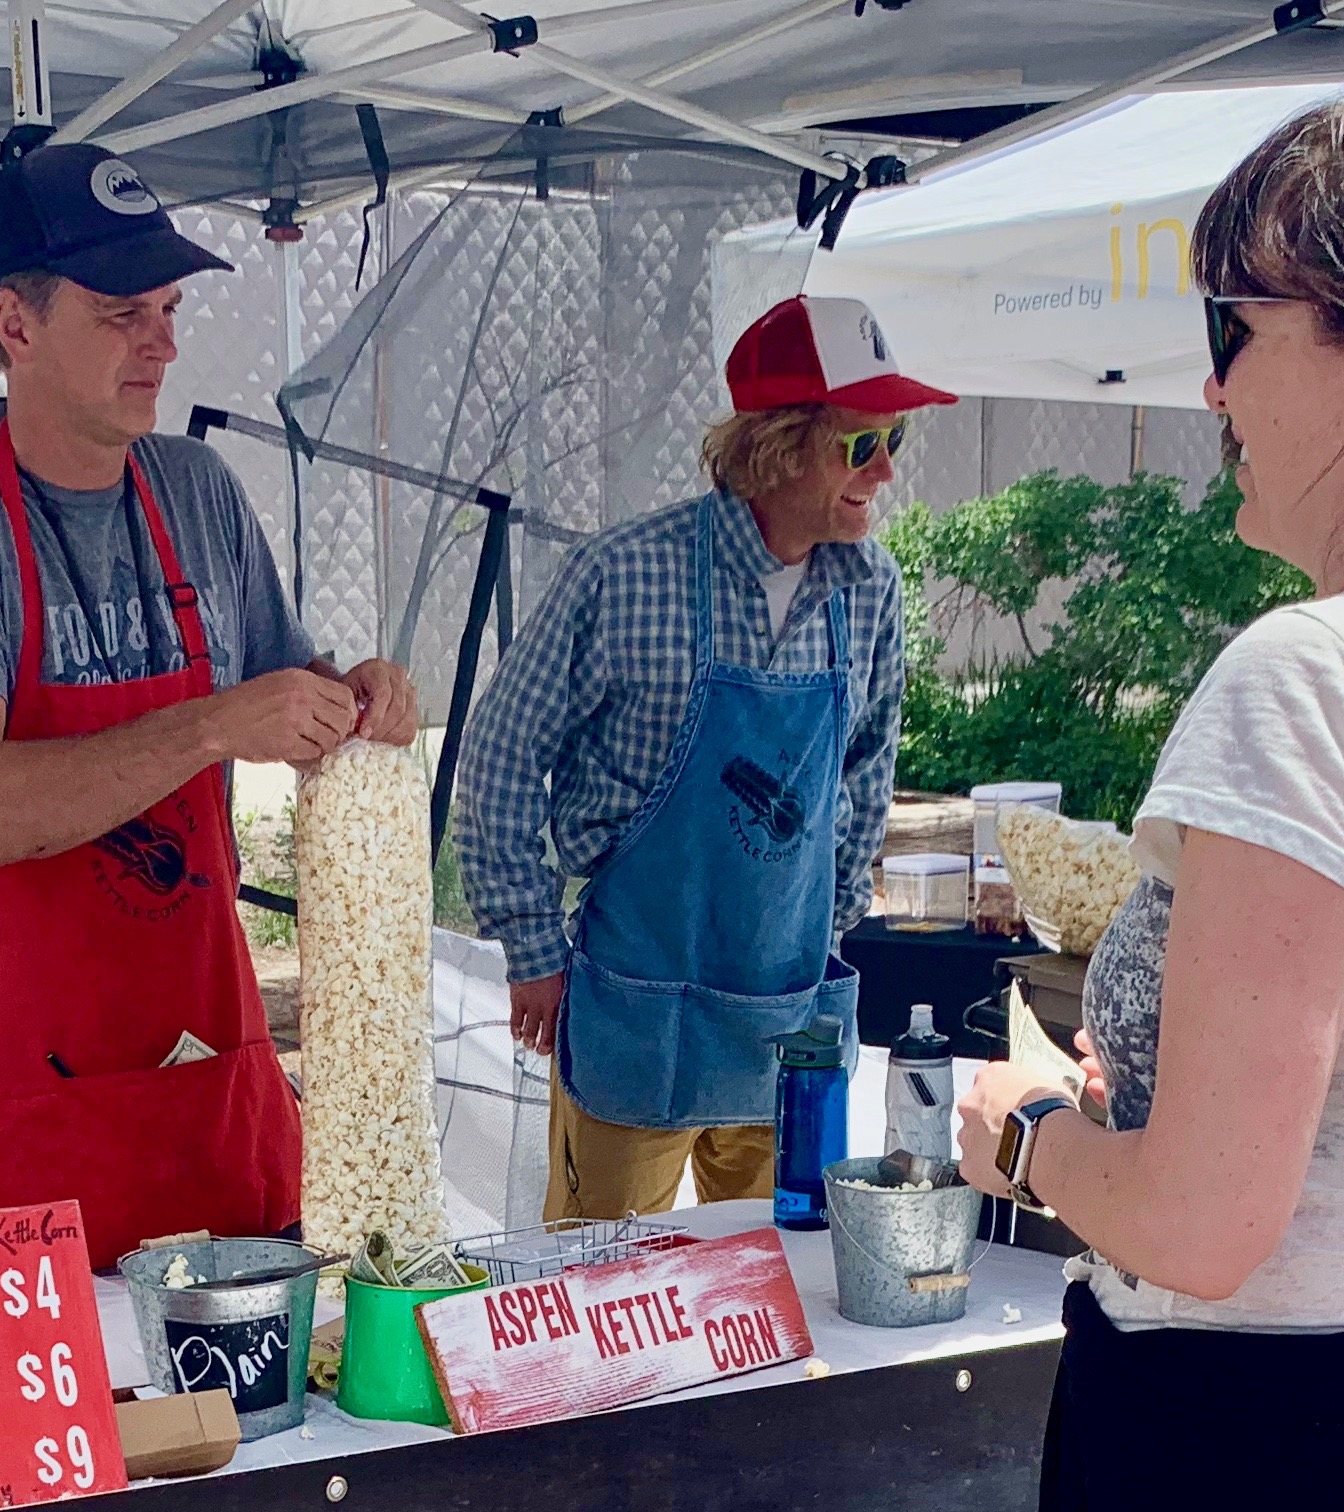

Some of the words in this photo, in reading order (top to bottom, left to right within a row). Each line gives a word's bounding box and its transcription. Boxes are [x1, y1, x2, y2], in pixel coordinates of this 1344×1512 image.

[994, 285, 1073, 315] Powered
[1078, 285, 1103, 310] by
[39, 1209, 78, 1246] Corn
[0, 1255, 61, 1319] $4
[484, 1280, 581, 1351] ASPEN
[585, 1284, 693, 1360] KETTLE
[704, 1307, 782, 1372] CORN
[17, 1342, 78, 1407] $6
[170, 1330, 290, 1398] Plain
[34, 1425, 95, 1489] $9
